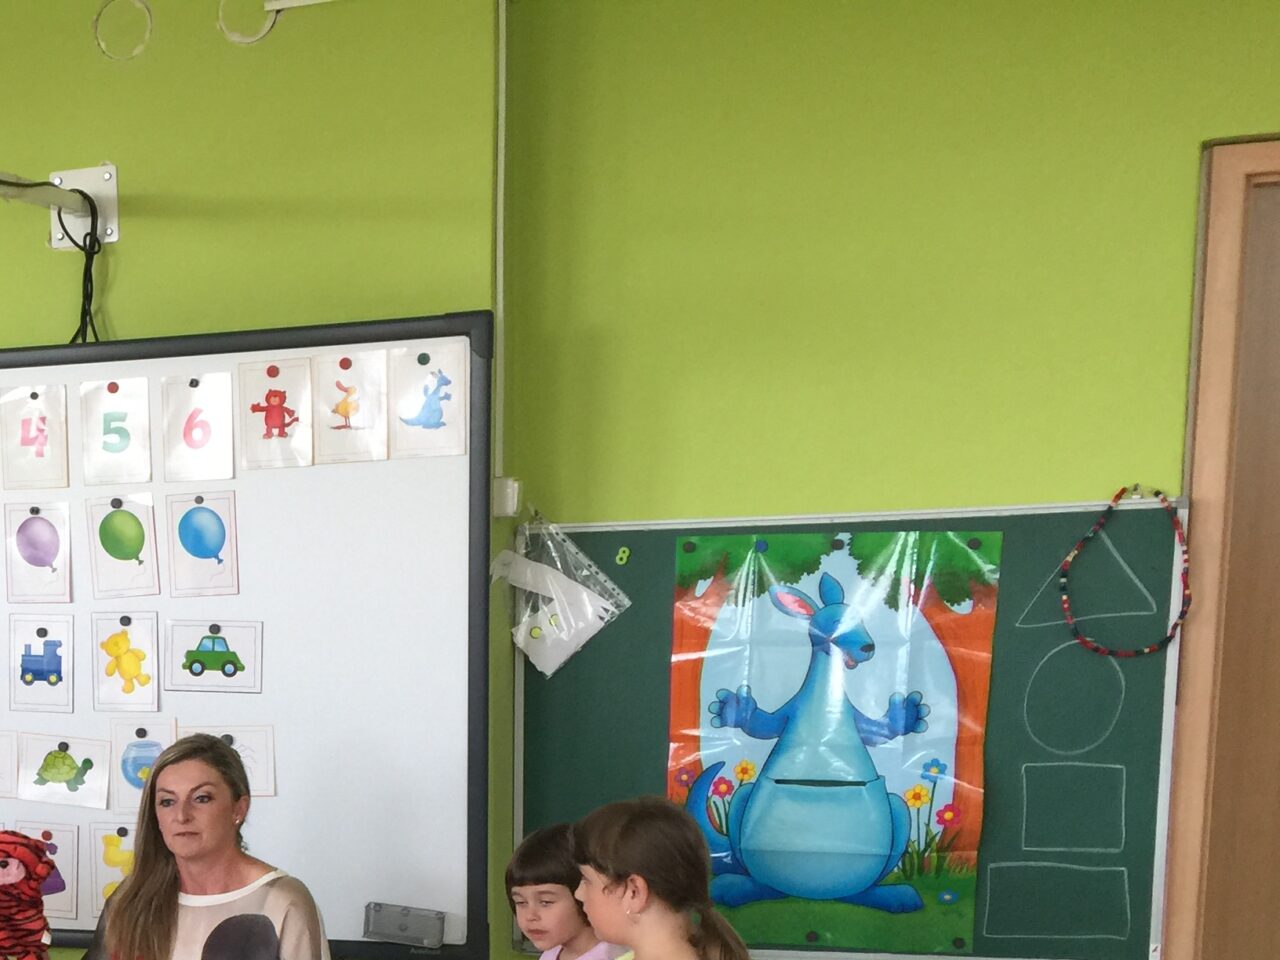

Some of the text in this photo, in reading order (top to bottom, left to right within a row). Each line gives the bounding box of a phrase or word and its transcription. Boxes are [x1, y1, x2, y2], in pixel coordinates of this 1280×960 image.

[20, 416, 48, 458] 4
[102, 411, 131, 454] 5
[182, 407, 212, 450] 6
[615, 546, 631, 566] 8
